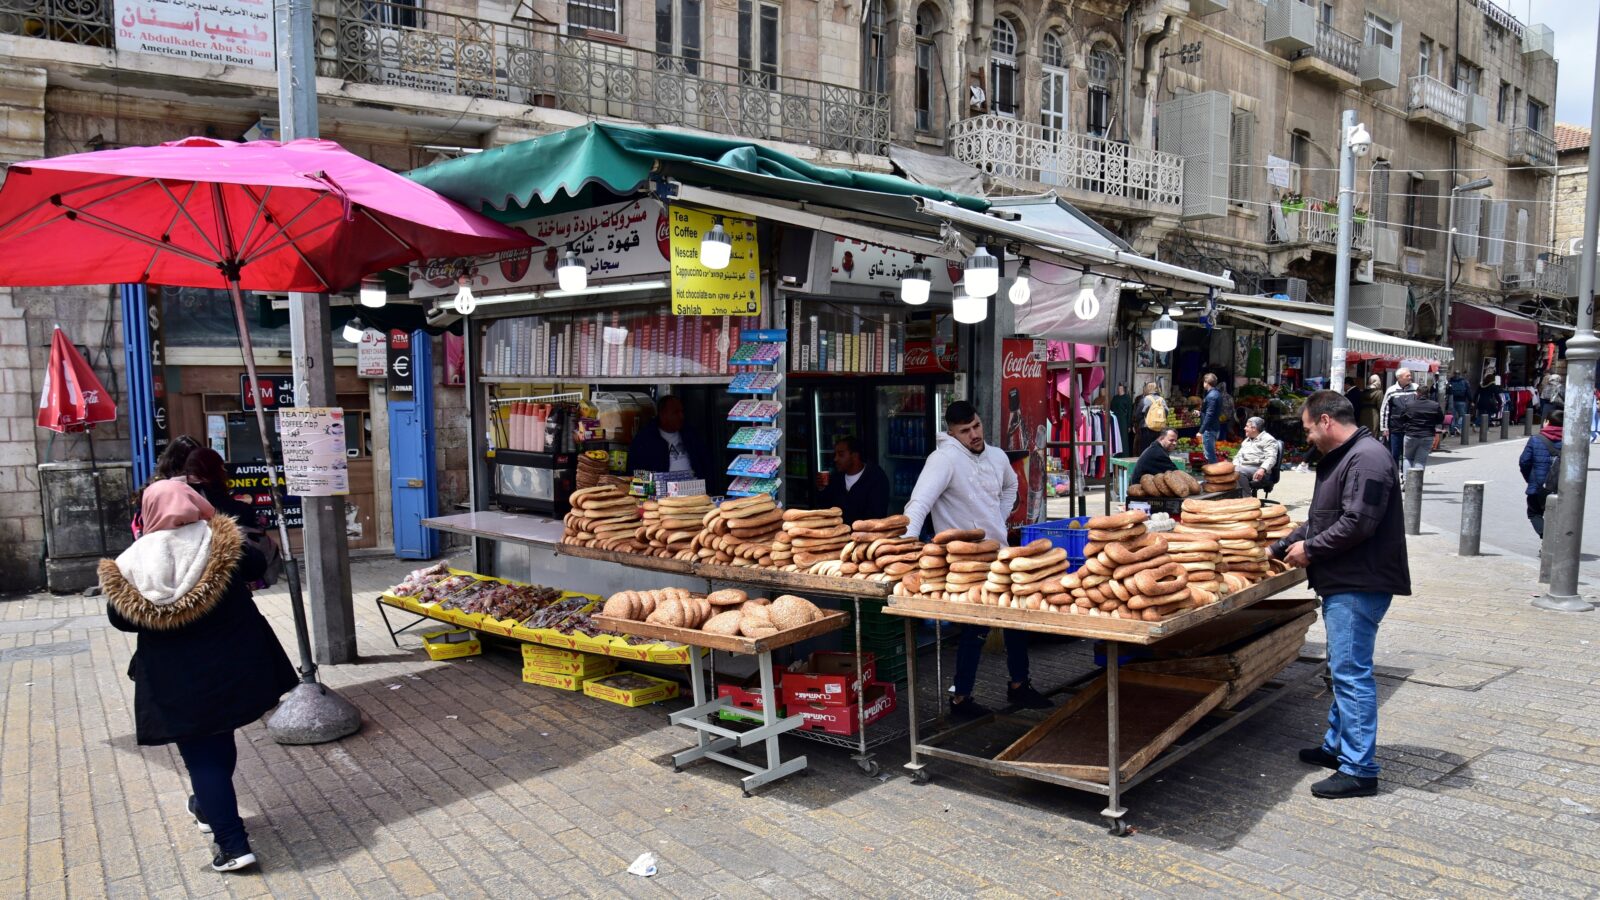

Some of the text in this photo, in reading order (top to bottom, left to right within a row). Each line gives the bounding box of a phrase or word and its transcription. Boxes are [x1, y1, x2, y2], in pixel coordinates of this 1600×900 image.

[121, 5, 268, 45] طبيب أسنان
[119, 28, 136, 40] Dr.
[139, 31, 208, 49] Abdulkader
[210, 41, 233, 53] Abu
[140, 43, 254, 65] American Dental Board
[537, 202, 647, 238] مشروبات باردة وساخنة
[674, 211, 689, 222] Tea
[674, 226, 698, 238] Coffee
[606, 230, 641, 254] قهوة
[674, 246, 699, 259] Nescafe
[676, 265, 703, 279] Cappuccino
[868, 259, 884, 280] شاي
[676, 289, 708, 299] Hot chocolate
[677, 304, 702, 315] Sahlab
[235, 465, 285, 474] AUTHOIZ
[226, 478, 259, 488] ONEY
